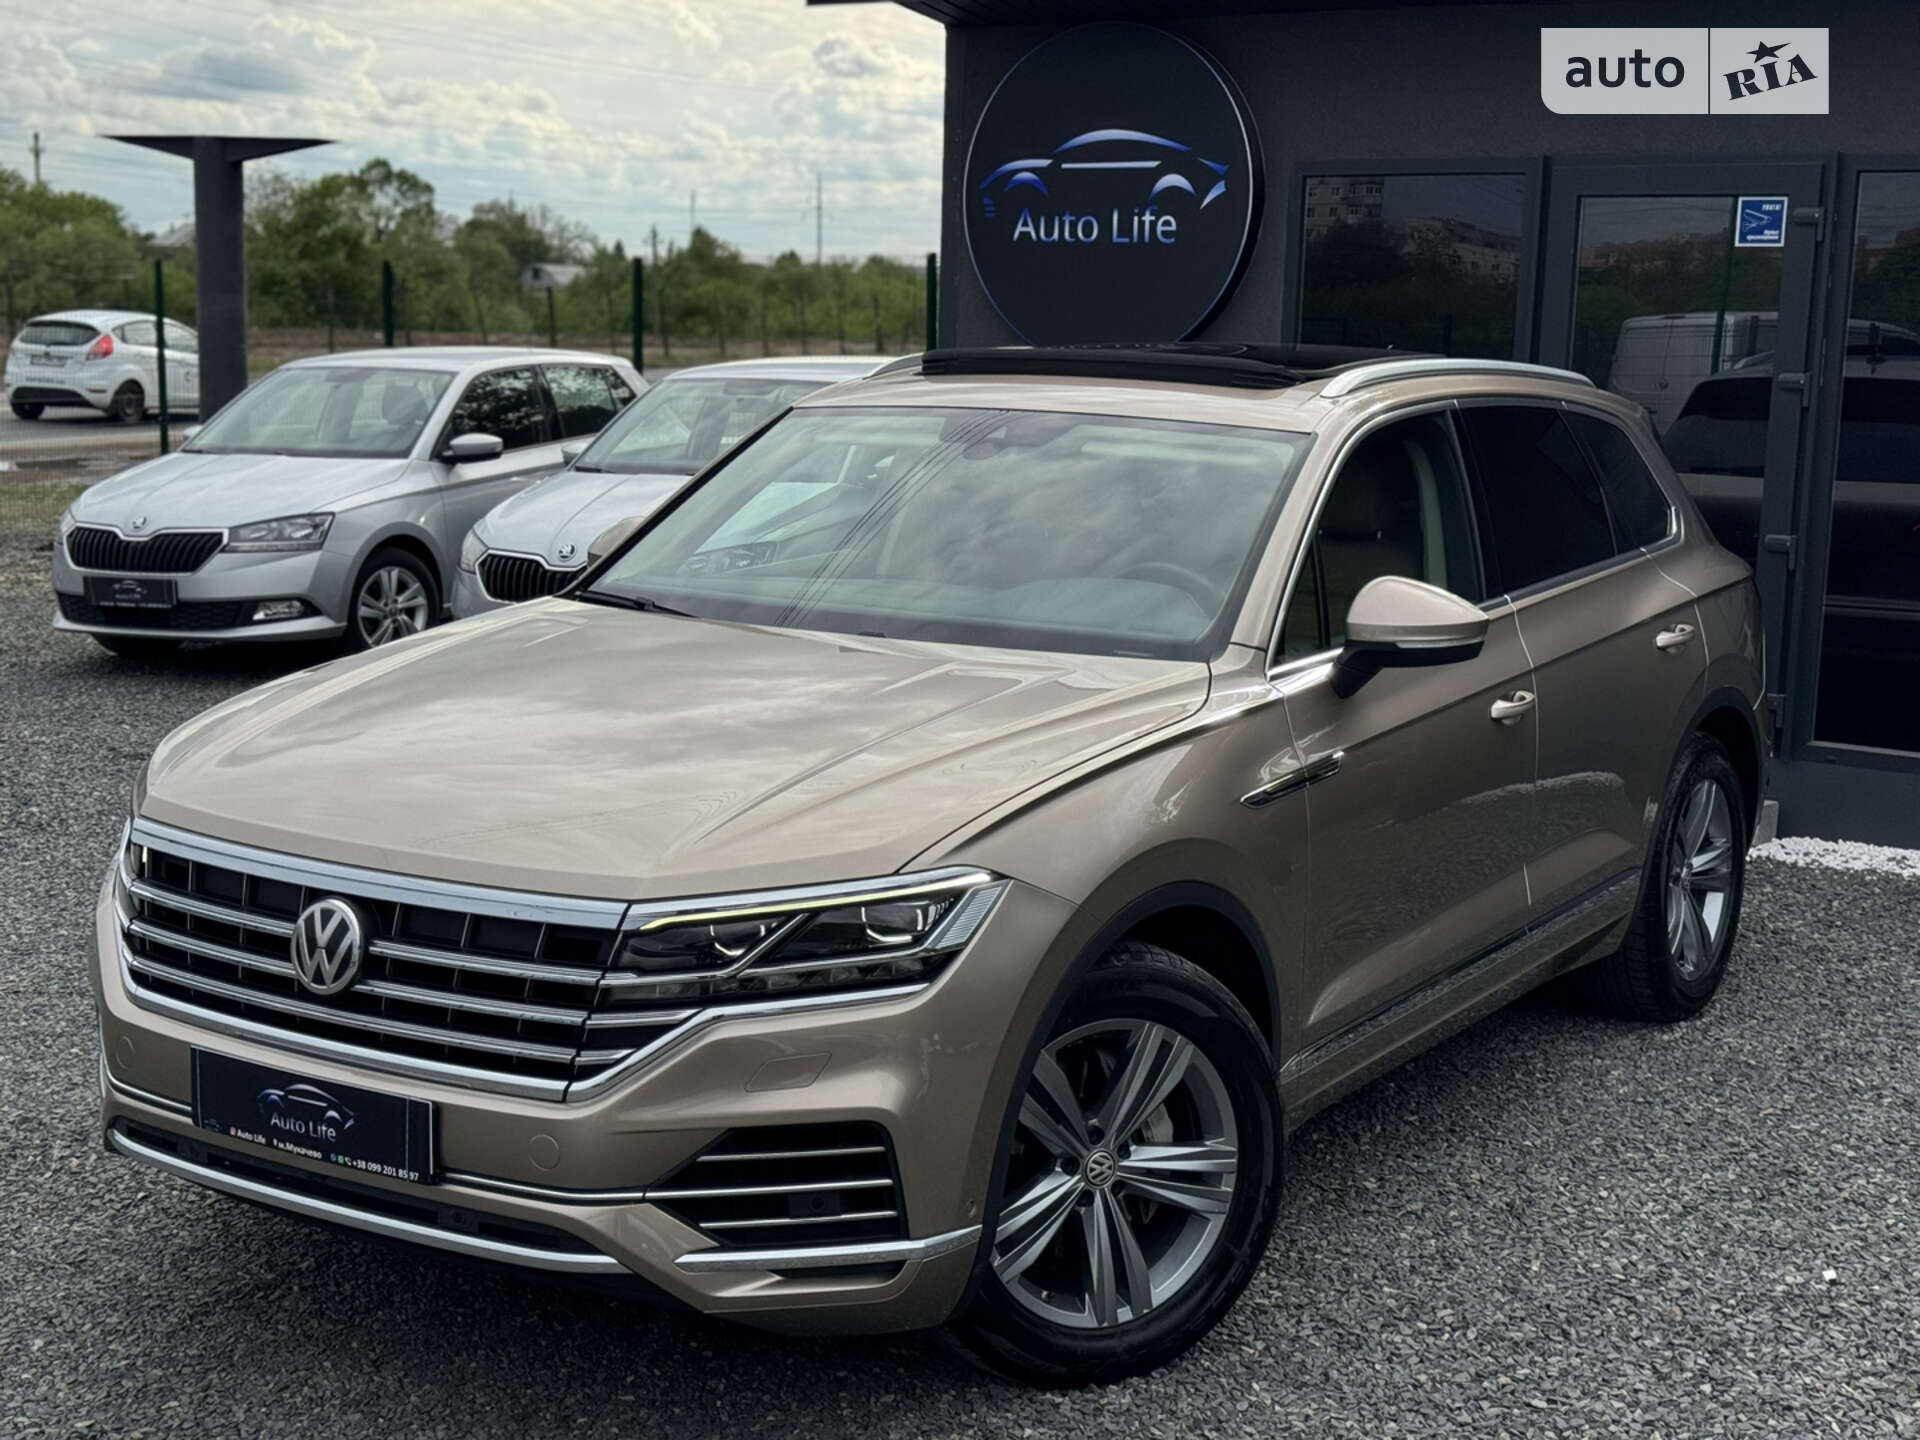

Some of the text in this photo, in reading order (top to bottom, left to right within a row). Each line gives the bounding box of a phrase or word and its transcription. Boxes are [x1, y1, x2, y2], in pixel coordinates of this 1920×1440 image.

[1012, 205, 1177, 243] Auto Life
[270, 1111, 337, 1142] Auto Life
[352, 1159, 420, 1182] +38 099 201 85 97
